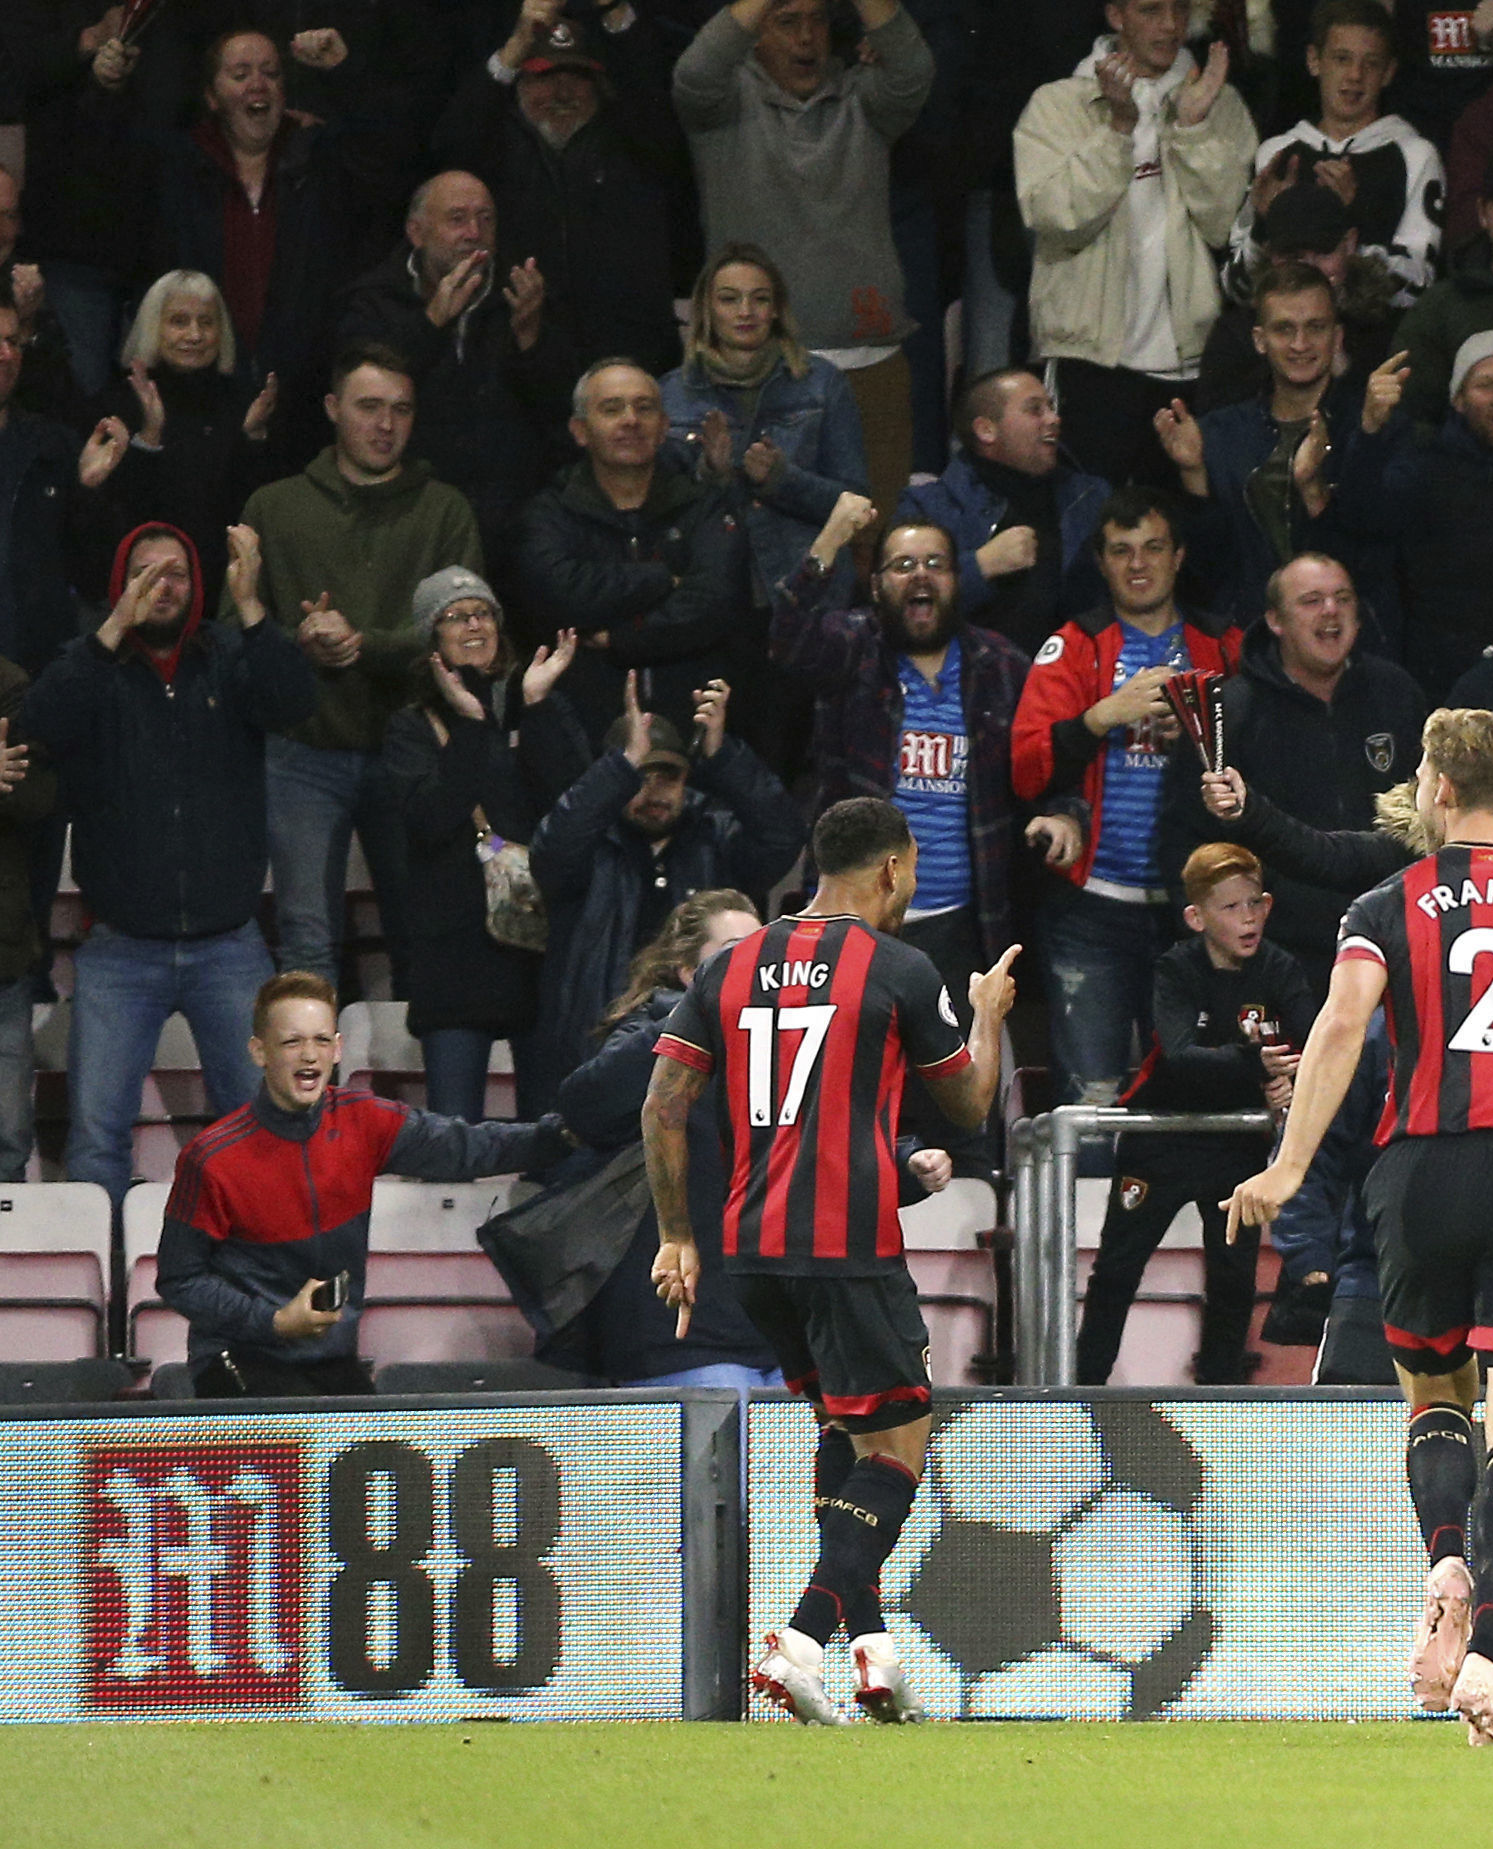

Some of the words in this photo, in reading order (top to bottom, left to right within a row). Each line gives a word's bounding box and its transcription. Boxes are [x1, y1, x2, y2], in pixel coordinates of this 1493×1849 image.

[759, 961, 829, 991] KING
[738, 1005, 838, 1126] 17
[1412, 1430, 1468, 1447] AFCB
[834, 1498, 879, 1528] AFCB
